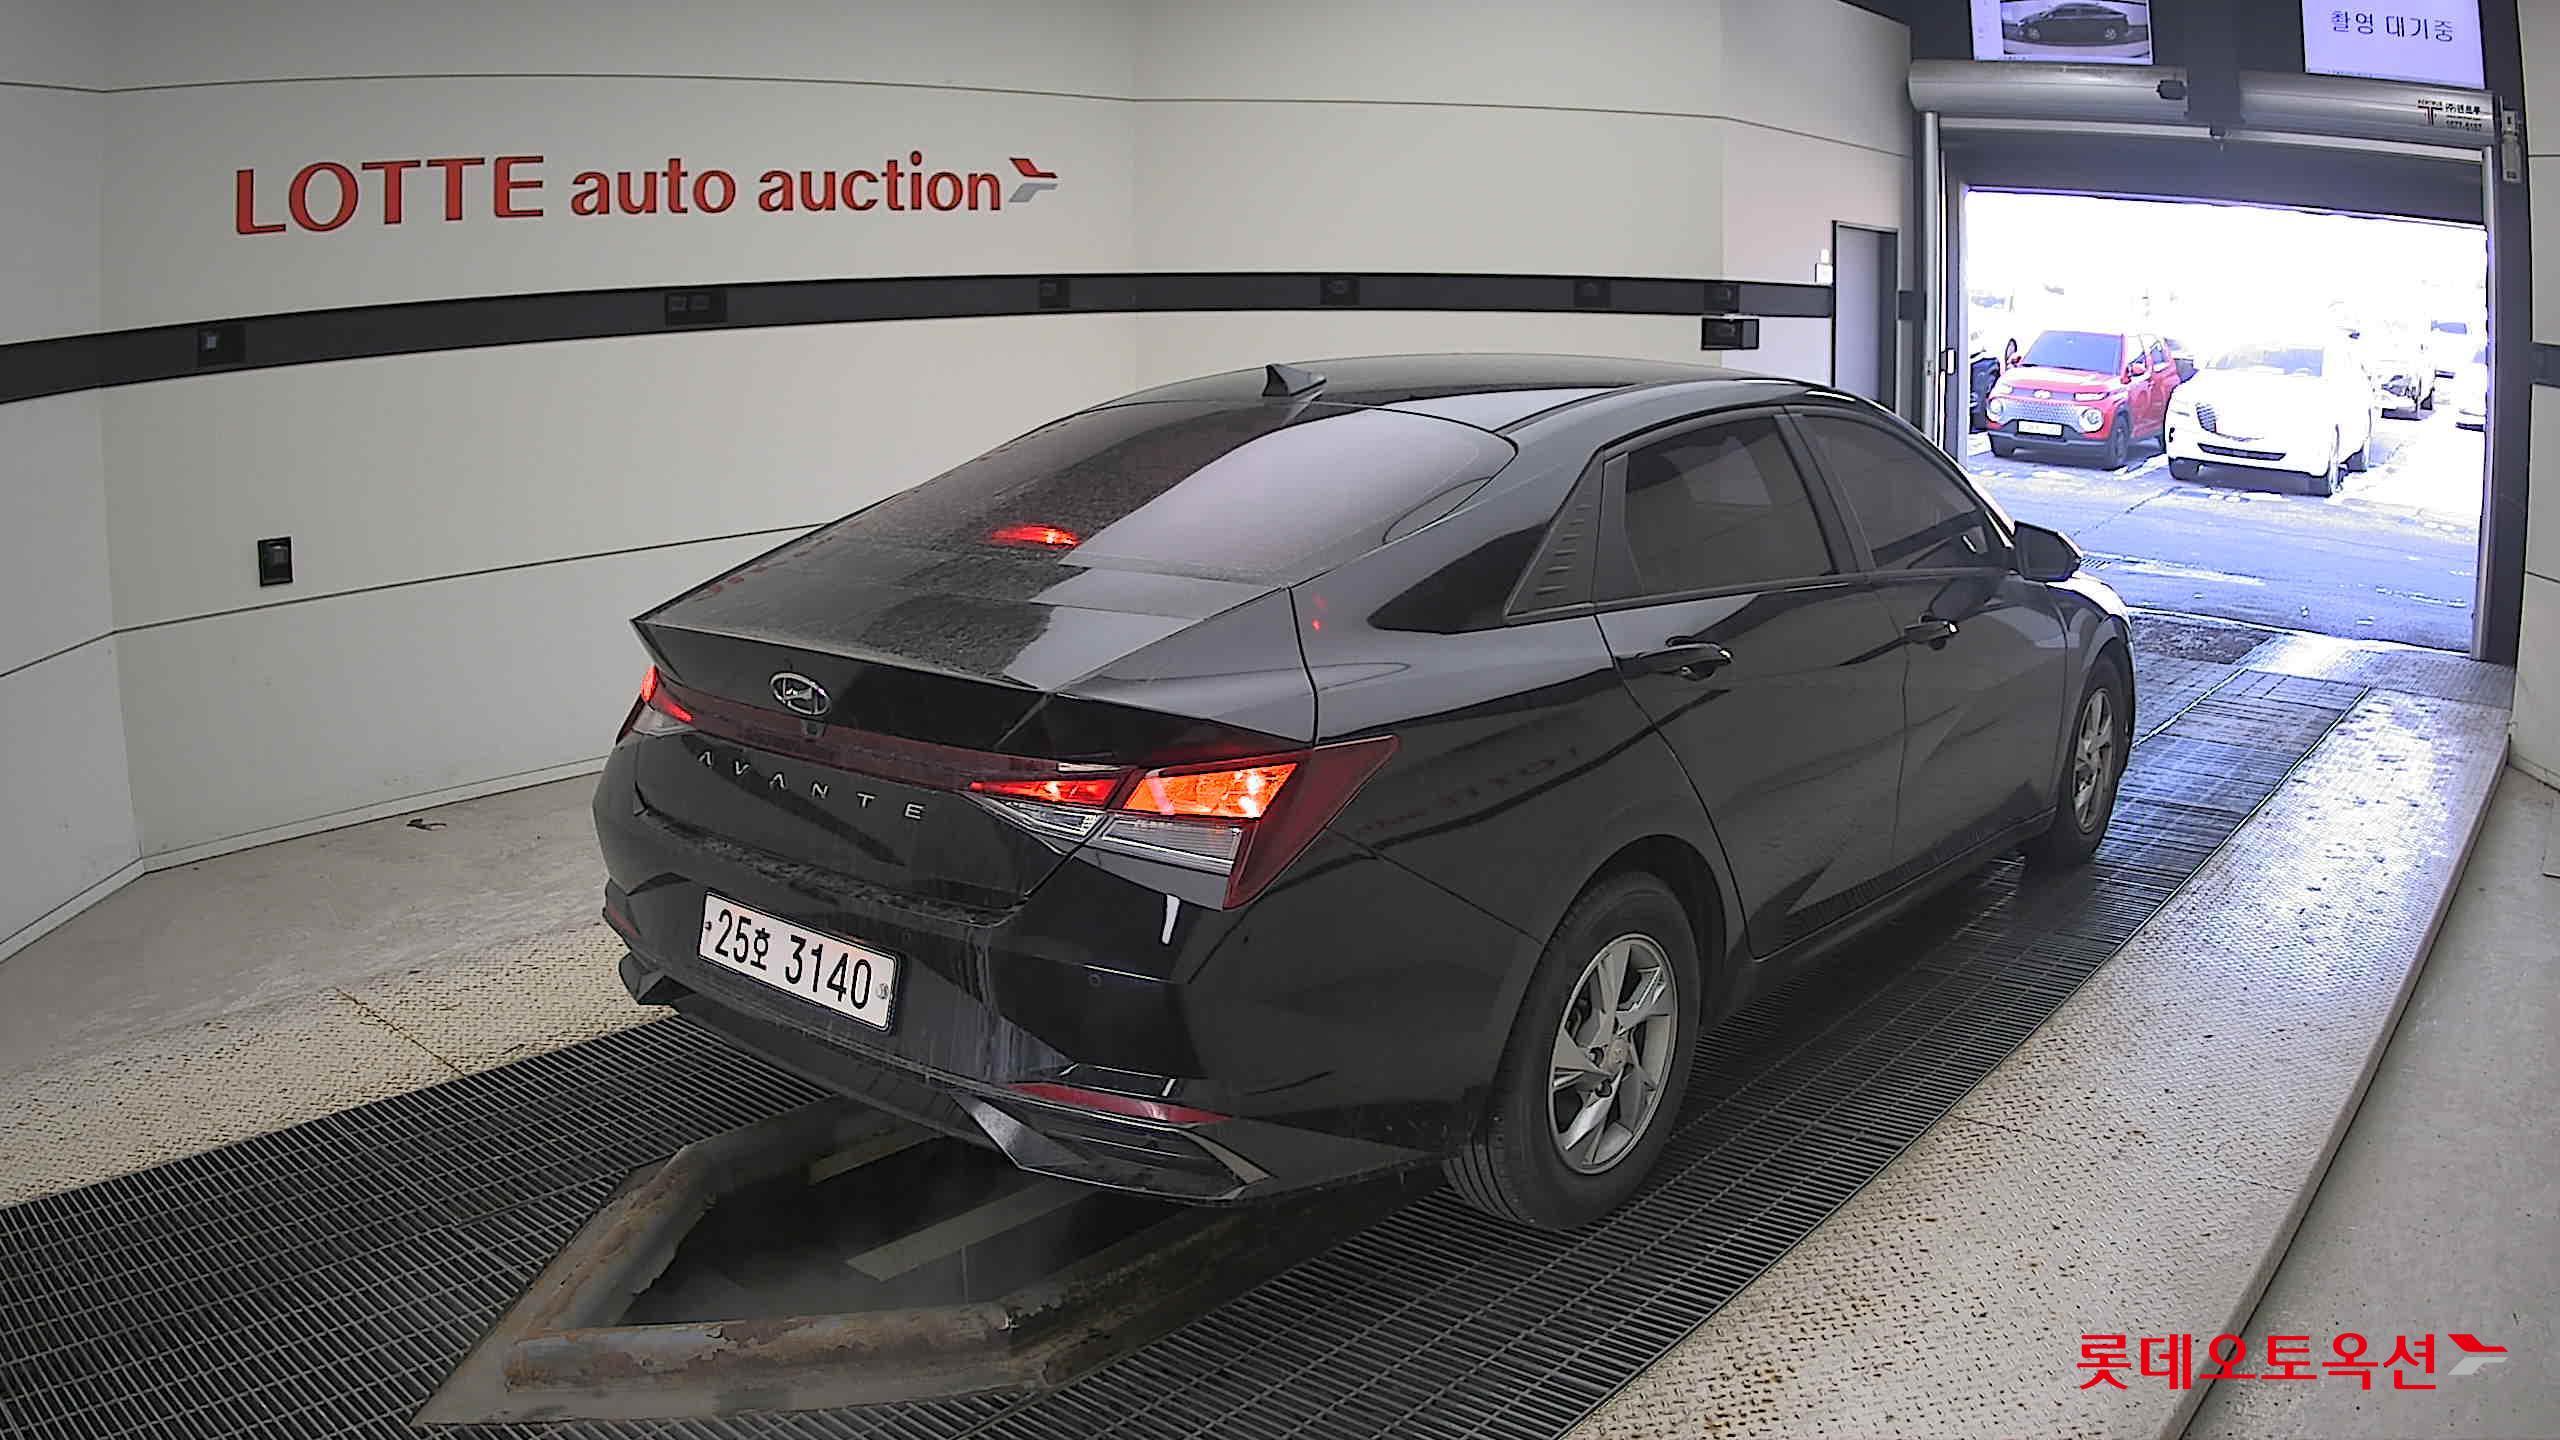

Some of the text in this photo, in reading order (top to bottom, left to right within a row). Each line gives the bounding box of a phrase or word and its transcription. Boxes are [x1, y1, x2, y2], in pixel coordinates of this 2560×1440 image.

[2331, 10, 2453, 42] 촬영 대기중
[237, 151, 1002, 234] LOTTE auto auction
[698, 751, 924, 820] AVANTE
[714, 909, 872, 1010] 25호 3140
